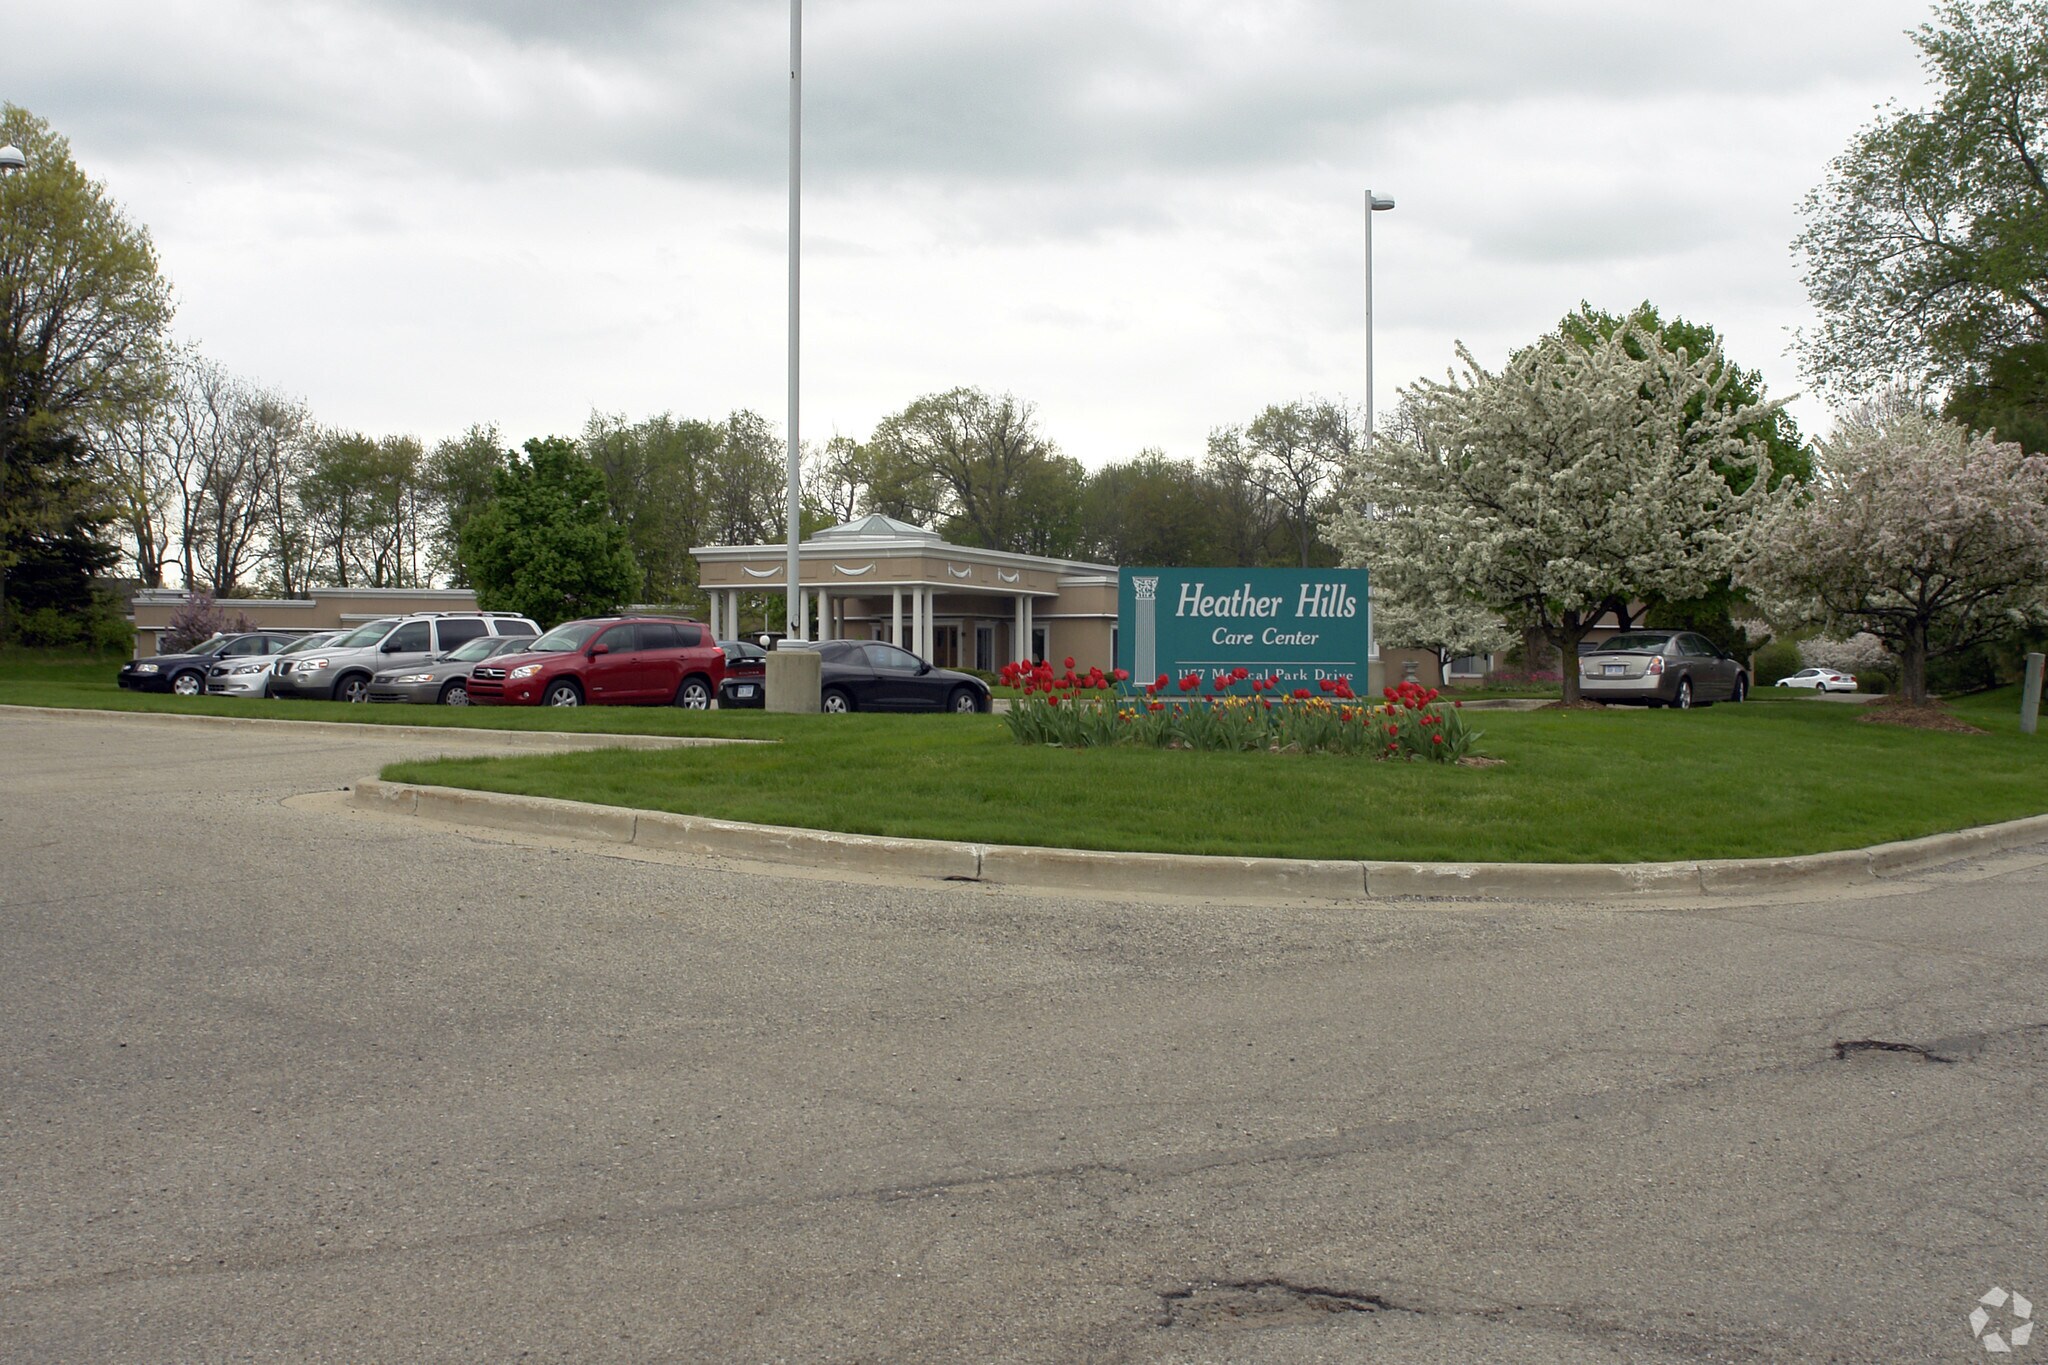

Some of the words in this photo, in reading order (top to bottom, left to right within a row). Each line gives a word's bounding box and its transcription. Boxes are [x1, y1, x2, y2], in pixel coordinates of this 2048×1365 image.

[1175, 583, 1283, 617] Heather
[1295, 583, 1357, 618] Hills
[1211, 627, 1254, 645] Care
[1261, 627, 1320, 645] Center
[1212, 668, 1269, 680] Mcal
[1275, 668, 1308, 680] Park
[1314, 668, 1354, 680] Drive
